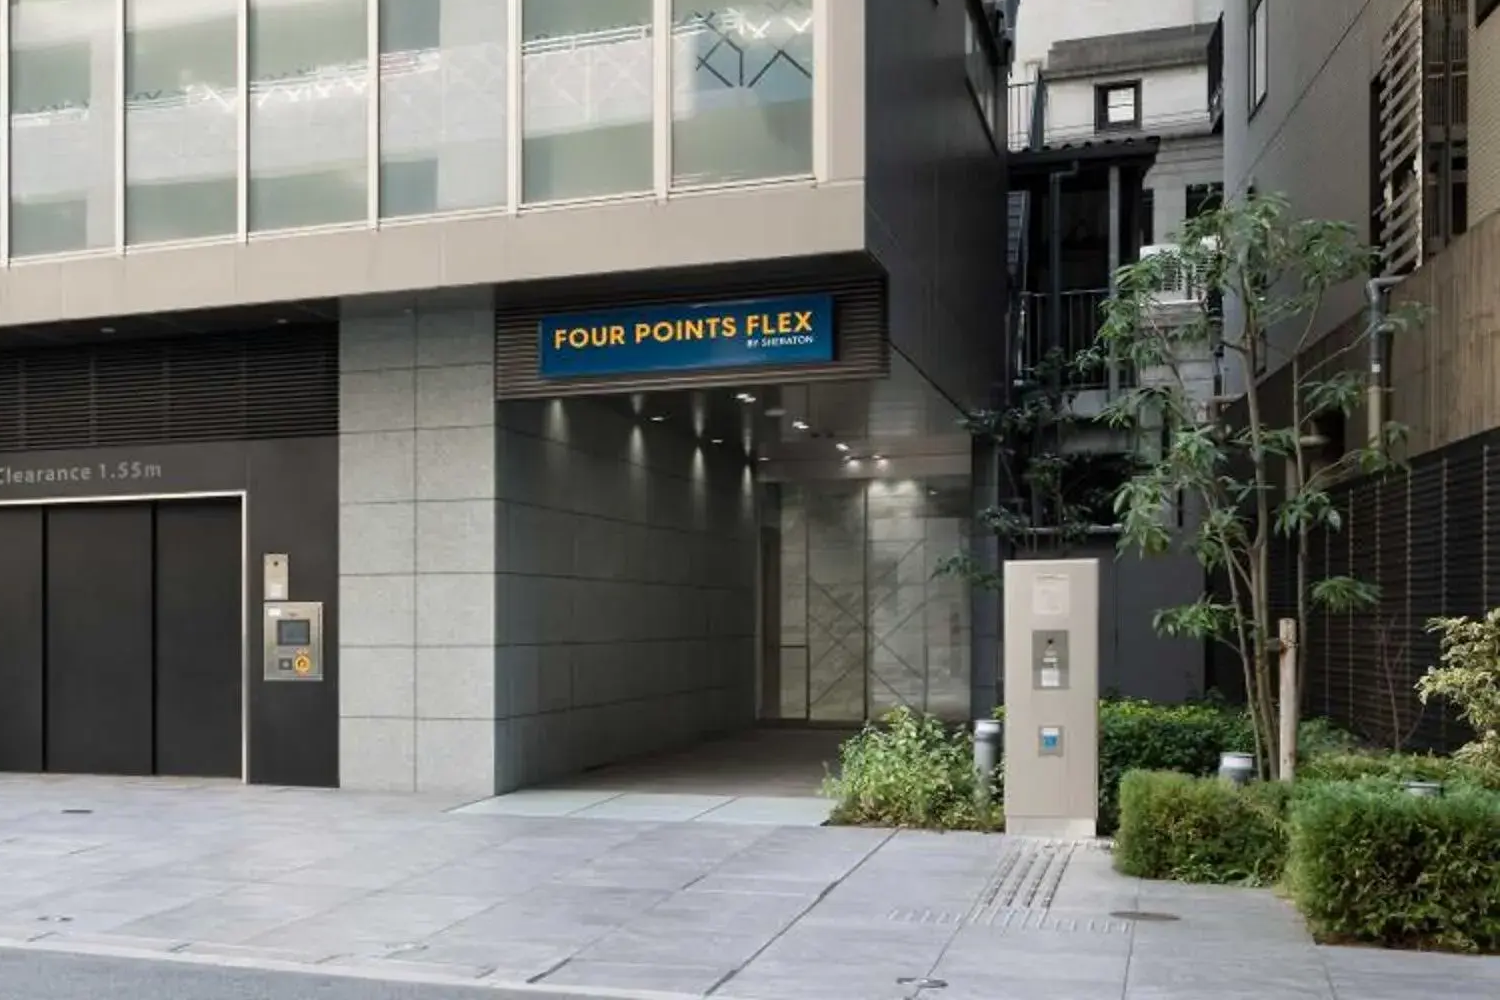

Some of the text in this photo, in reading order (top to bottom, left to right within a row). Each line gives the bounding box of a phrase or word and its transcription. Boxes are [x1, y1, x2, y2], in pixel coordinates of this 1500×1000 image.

[554, 310, 813, 350] FOUR POINTS FLEX
[761, 335, 814, 347] SHERATON
[99, 461, 162, 481] 1.55m
